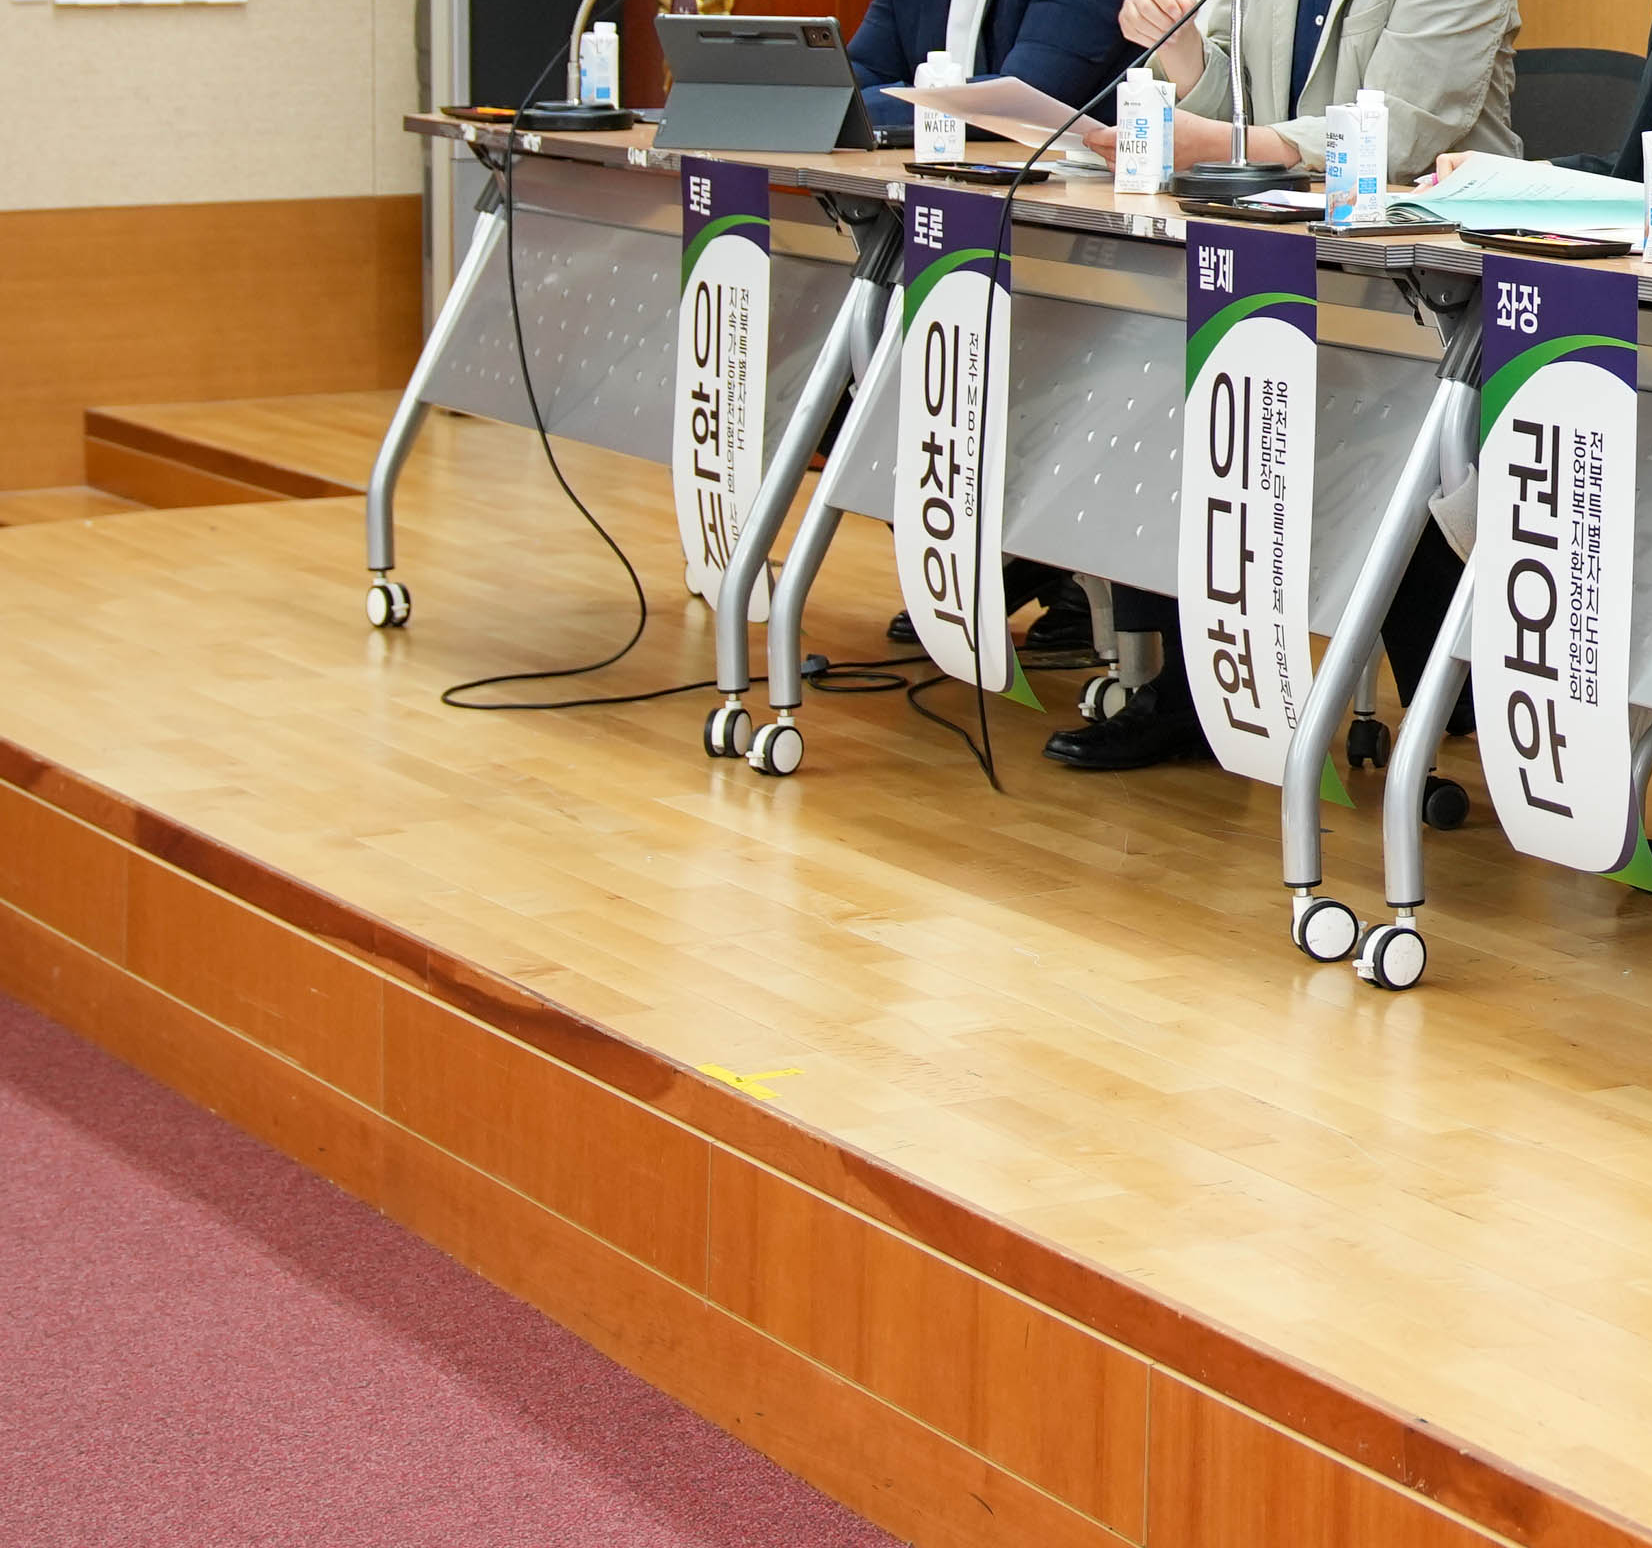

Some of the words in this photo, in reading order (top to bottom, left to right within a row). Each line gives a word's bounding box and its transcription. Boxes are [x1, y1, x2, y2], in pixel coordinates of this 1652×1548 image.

[924, 120, 956, 132] WATER
[1119, 140, 1148, 154] WATER
[689, 175, 712, 217] 토론
[913, 206, 944, 250] 토론
[1198, 245, 1235, 294] 발제
[1497, 281, 1541, 334] 좌장
[737, 288, 751, 451] 전북특별자치도
[966, 332, 980, 457] 전주MBC
[1275, 381, 1289, 465] 옥천군
[920, 320, 976, 652] 이창익
[964, 467, 975, 517] 국장
[1206, 372, 1270, 739] 이다현
[1271, 475, 1285, 614] 마을공동체
[1569, 428, 1589, 702] 농업복지환경위원회
[1586, 431, 1605, 709] 전북특별자치도의회
[1504, 420, 1573, 820] 권요안
